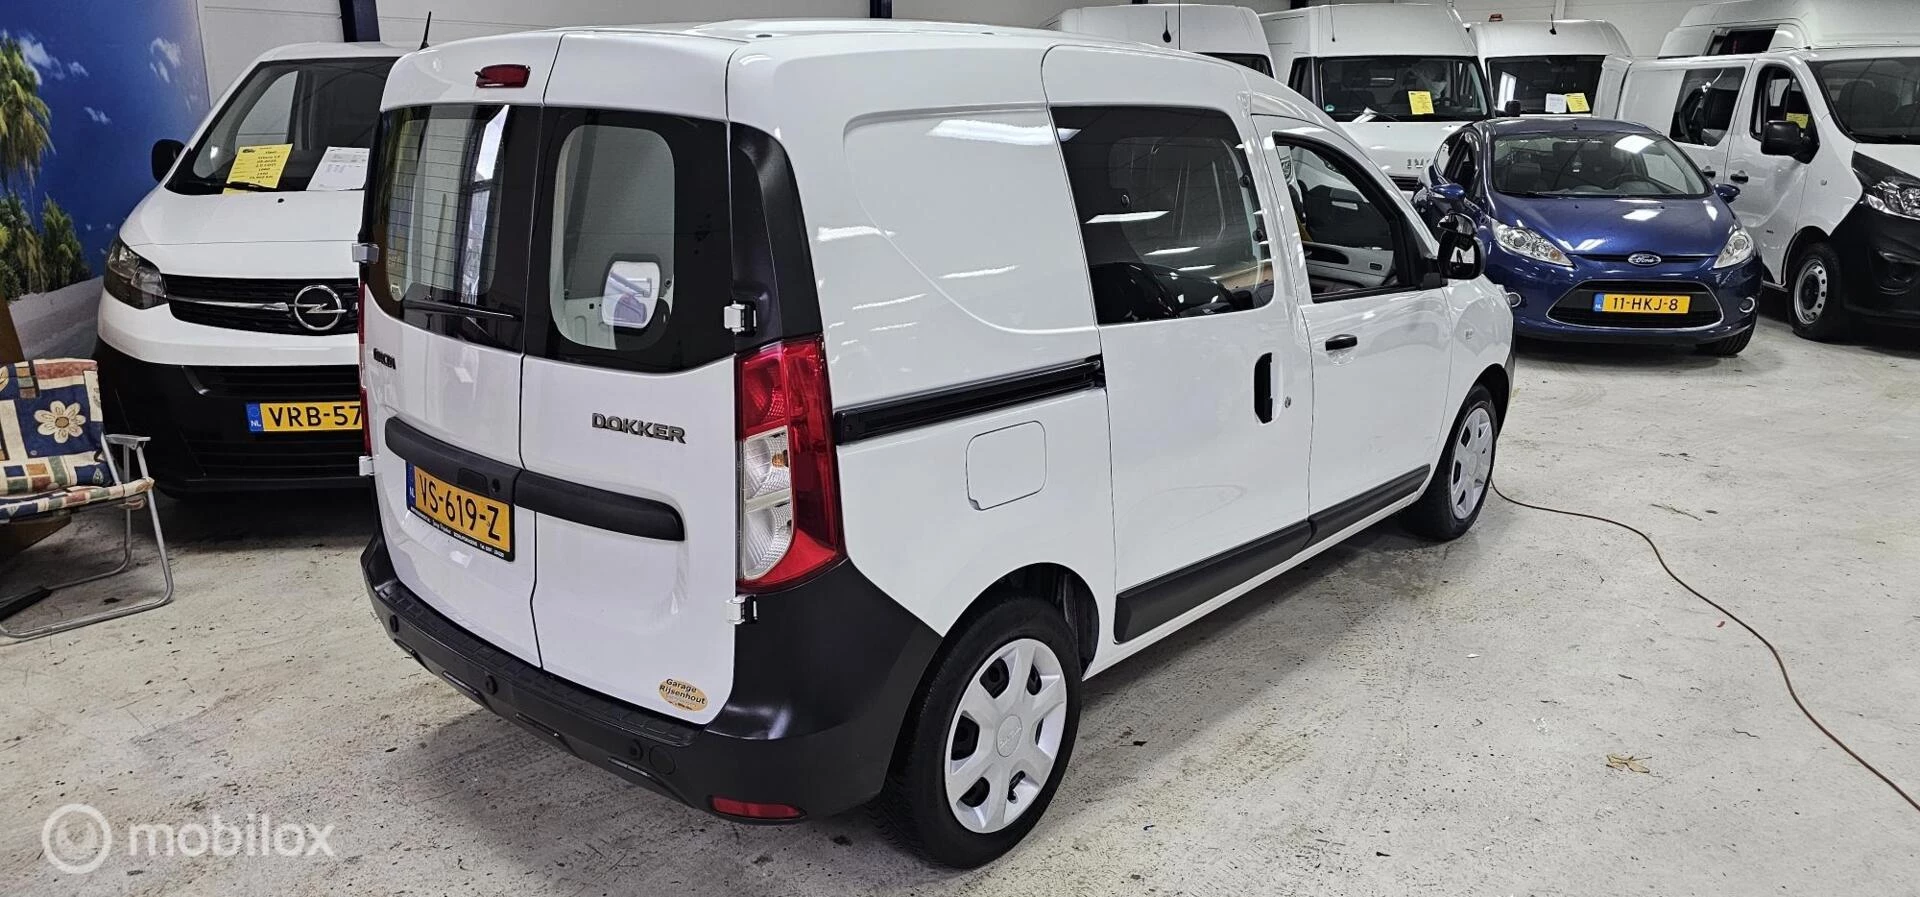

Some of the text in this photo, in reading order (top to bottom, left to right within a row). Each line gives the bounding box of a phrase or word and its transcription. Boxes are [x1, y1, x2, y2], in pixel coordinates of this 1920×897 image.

[1613, 297, 1678, 311] 11-HKJ-8
[268, 405, 361, 427] VRB-57
[591, 412, 687, 444] DOKKER
[409, 486, 416, 498] NL
[418, 473, 501, 542] VS-619-Z
[659, 684, 706, 705] Rijsenhout
[666, 678, 697, 693] Garage
